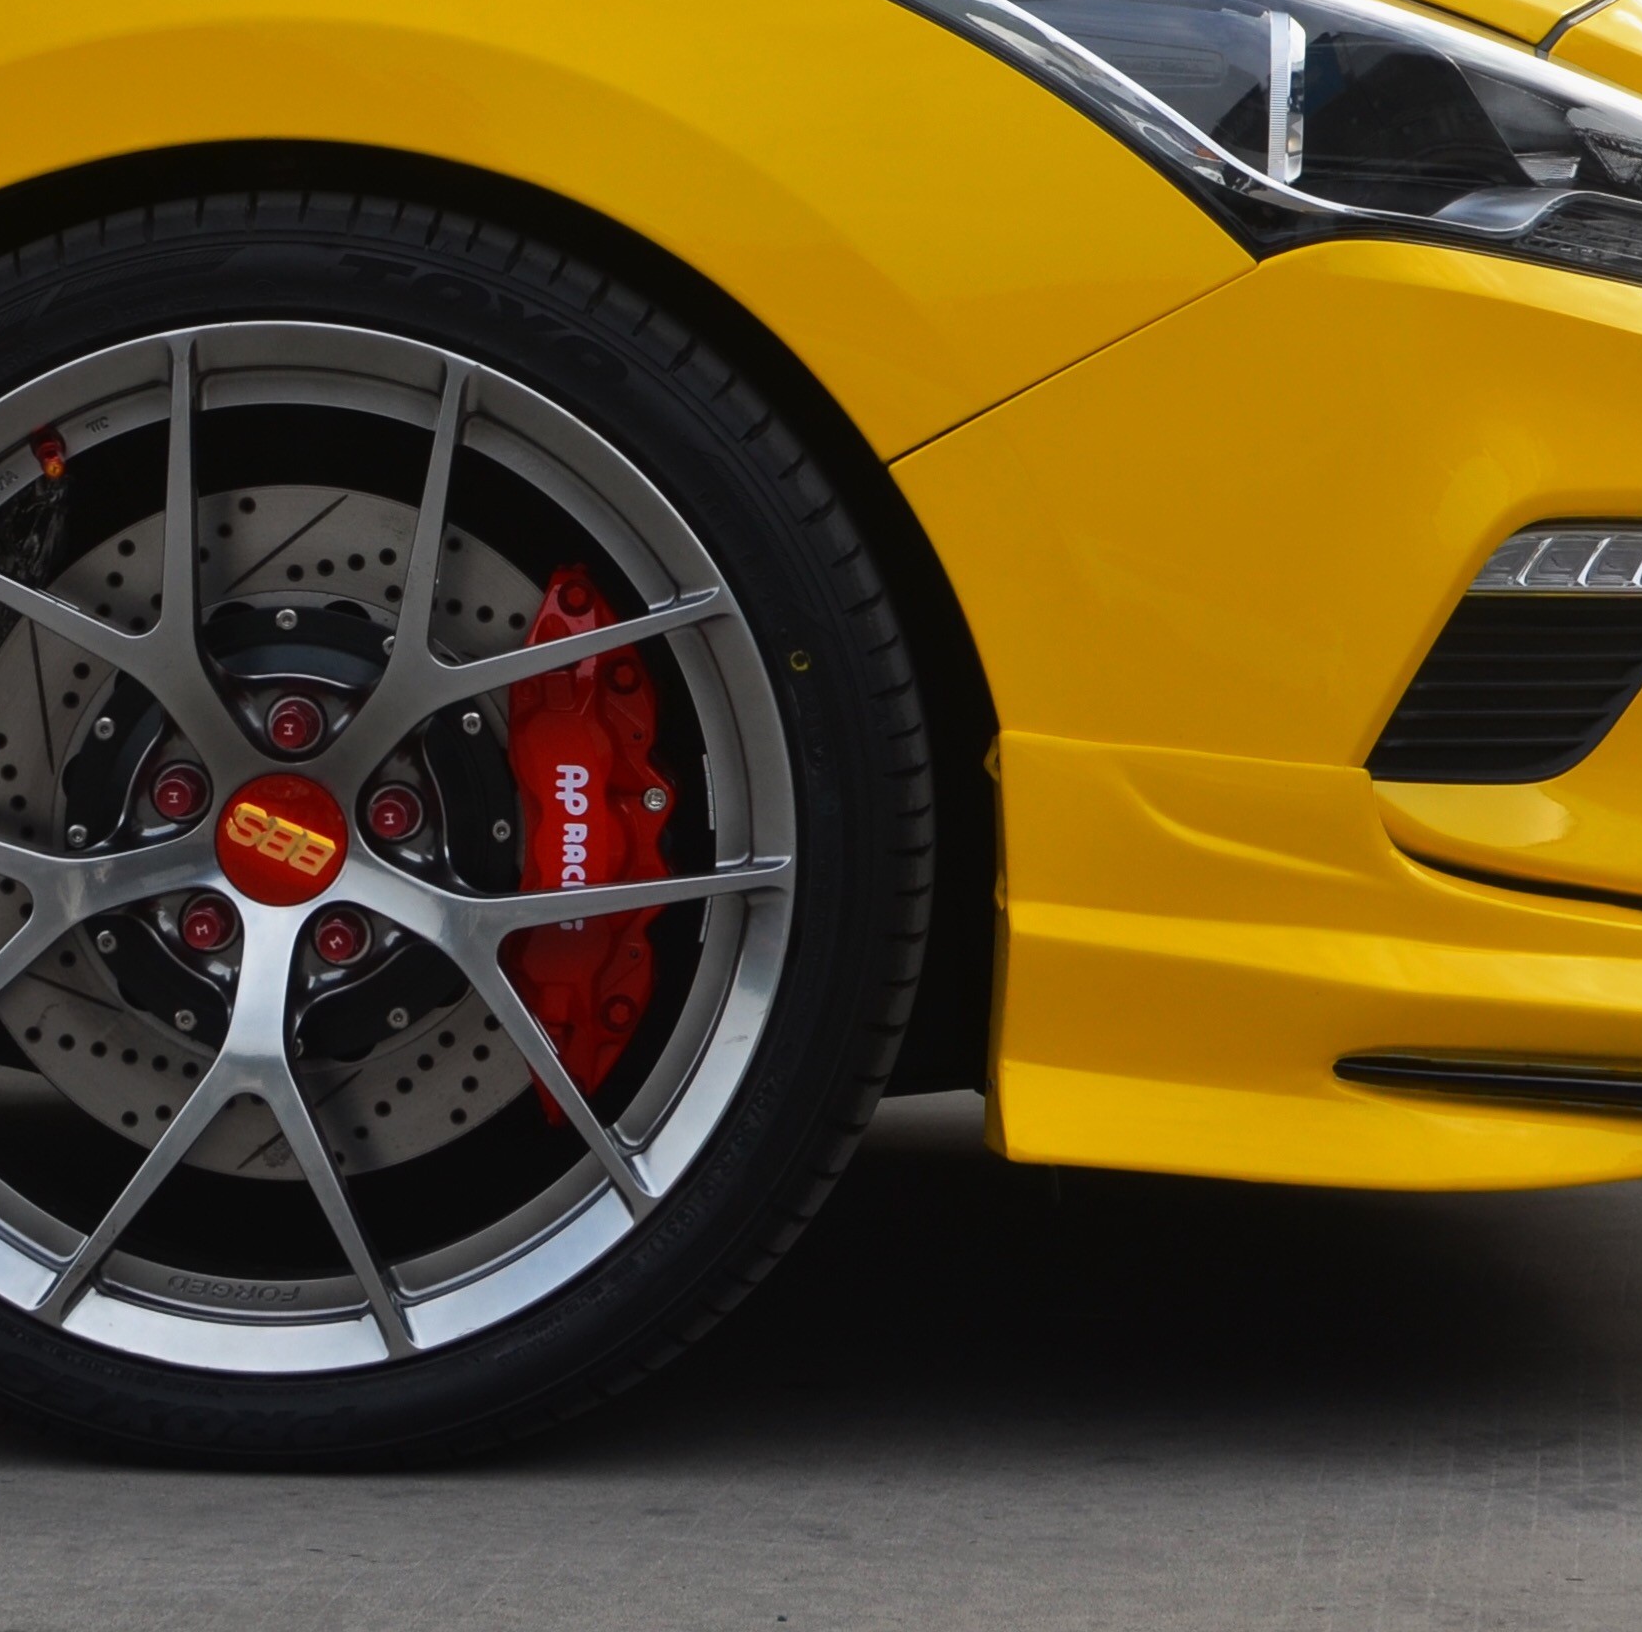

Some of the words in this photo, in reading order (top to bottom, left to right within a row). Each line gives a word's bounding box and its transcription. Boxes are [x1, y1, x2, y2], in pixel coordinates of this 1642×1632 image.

[555, 764, 589, 816] AP
[225, 802, 338, 876] BBS
[167, 1274, 301, 1302] FORGED
